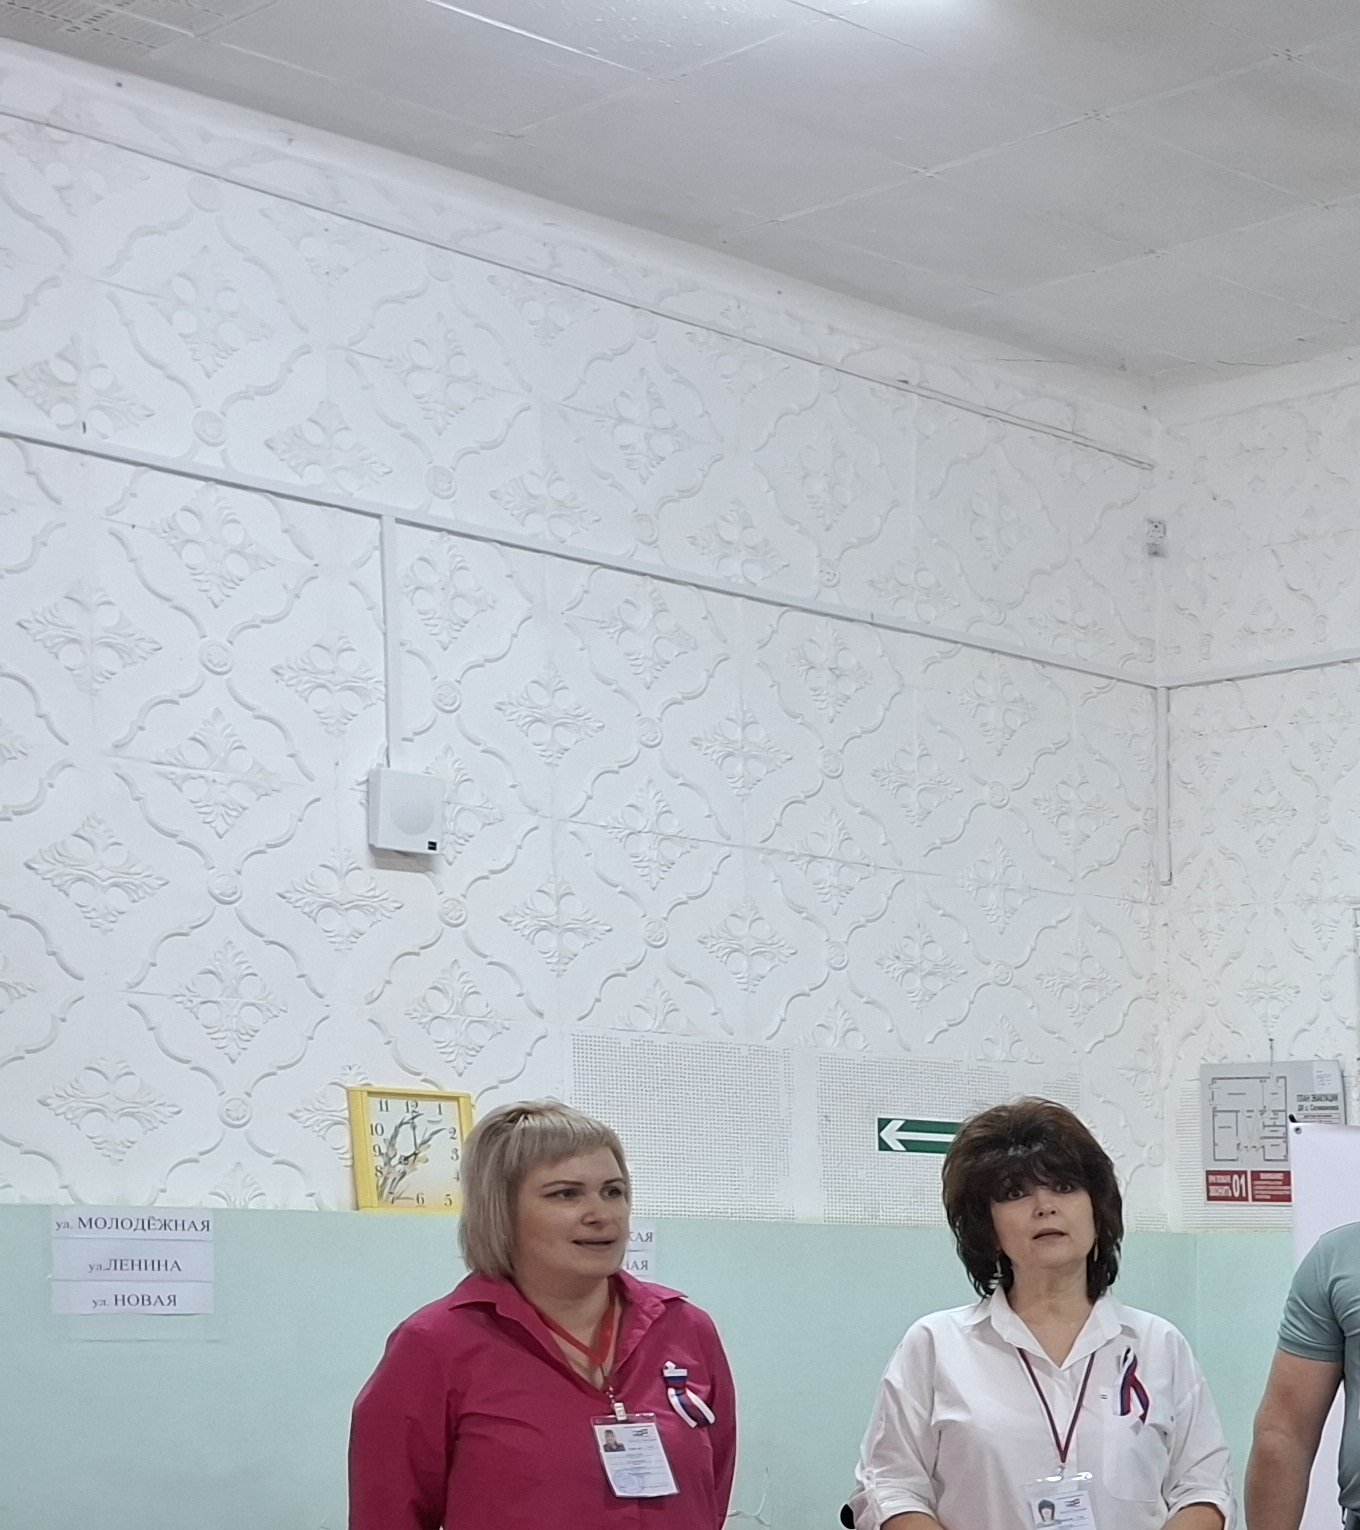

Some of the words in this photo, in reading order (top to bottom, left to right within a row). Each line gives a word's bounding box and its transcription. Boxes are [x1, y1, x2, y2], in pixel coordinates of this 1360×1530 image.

[380, 1099, 389, 1112] 11
[405, 1100, 419, 1113] 12
[370, 1122, 384, 1136] 10
[448, 1127, 457, 1140] 2
[450, 1147, 459, 1161] 3
[1232, 1173, 1246, 1198] 01
[416, 1192, 425, 1205] 6
[444, 1194, 453, 1207] 5
[78, 1215, 211, 1232] МОЛОДЁЖНАЯ
[113, 1293, 177, 1307] НОВАЯ
